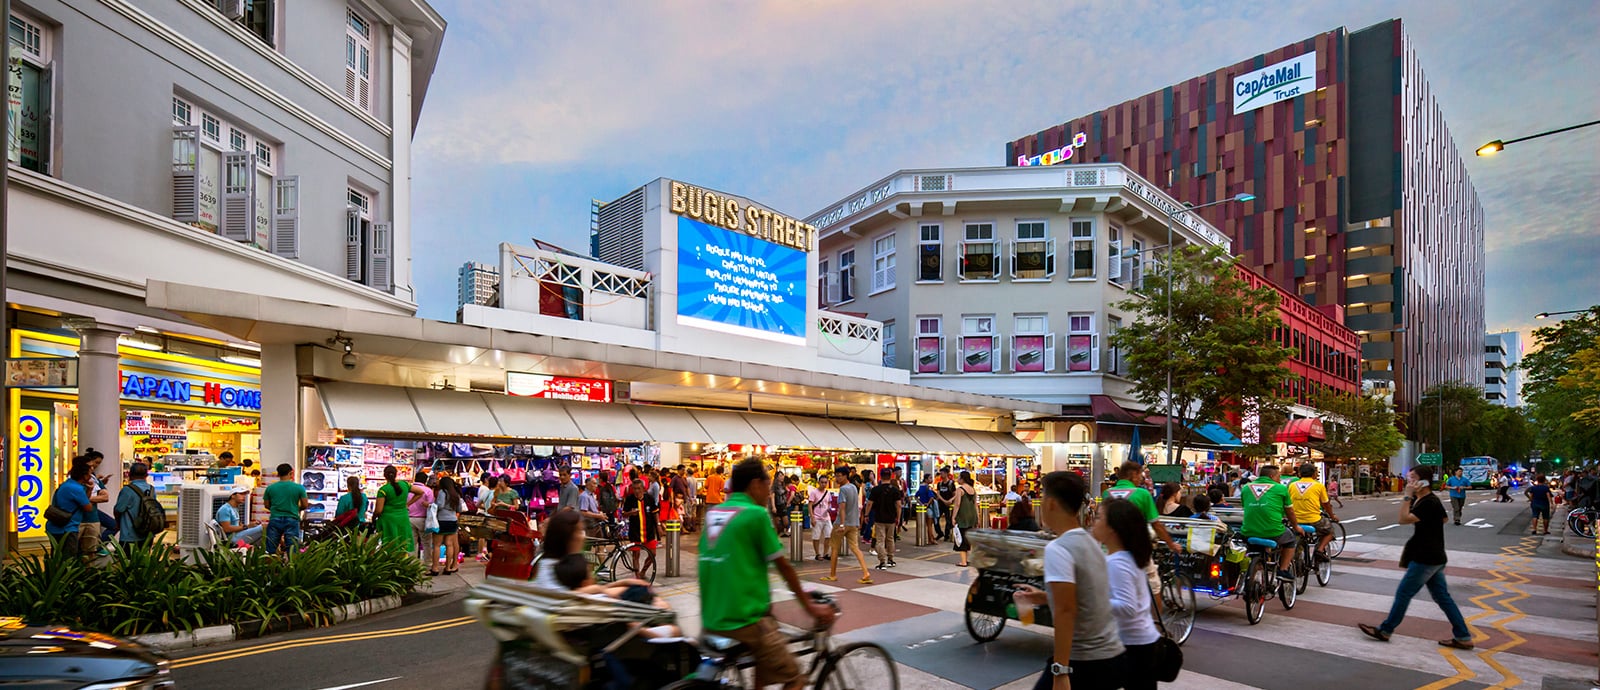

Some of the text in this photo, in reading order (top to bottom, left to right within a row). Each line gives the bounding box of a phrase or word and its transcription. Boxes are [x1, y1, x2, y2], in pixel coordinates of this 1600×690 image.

[1236, 62, 1301, 97] CapitaMall
[1273, 86, 1300, 100] Trust
[200, 212, 213, 221] are
[671, 180, 815, 252] BUGIS STREET
[119, 370, 190, 401] APAN
